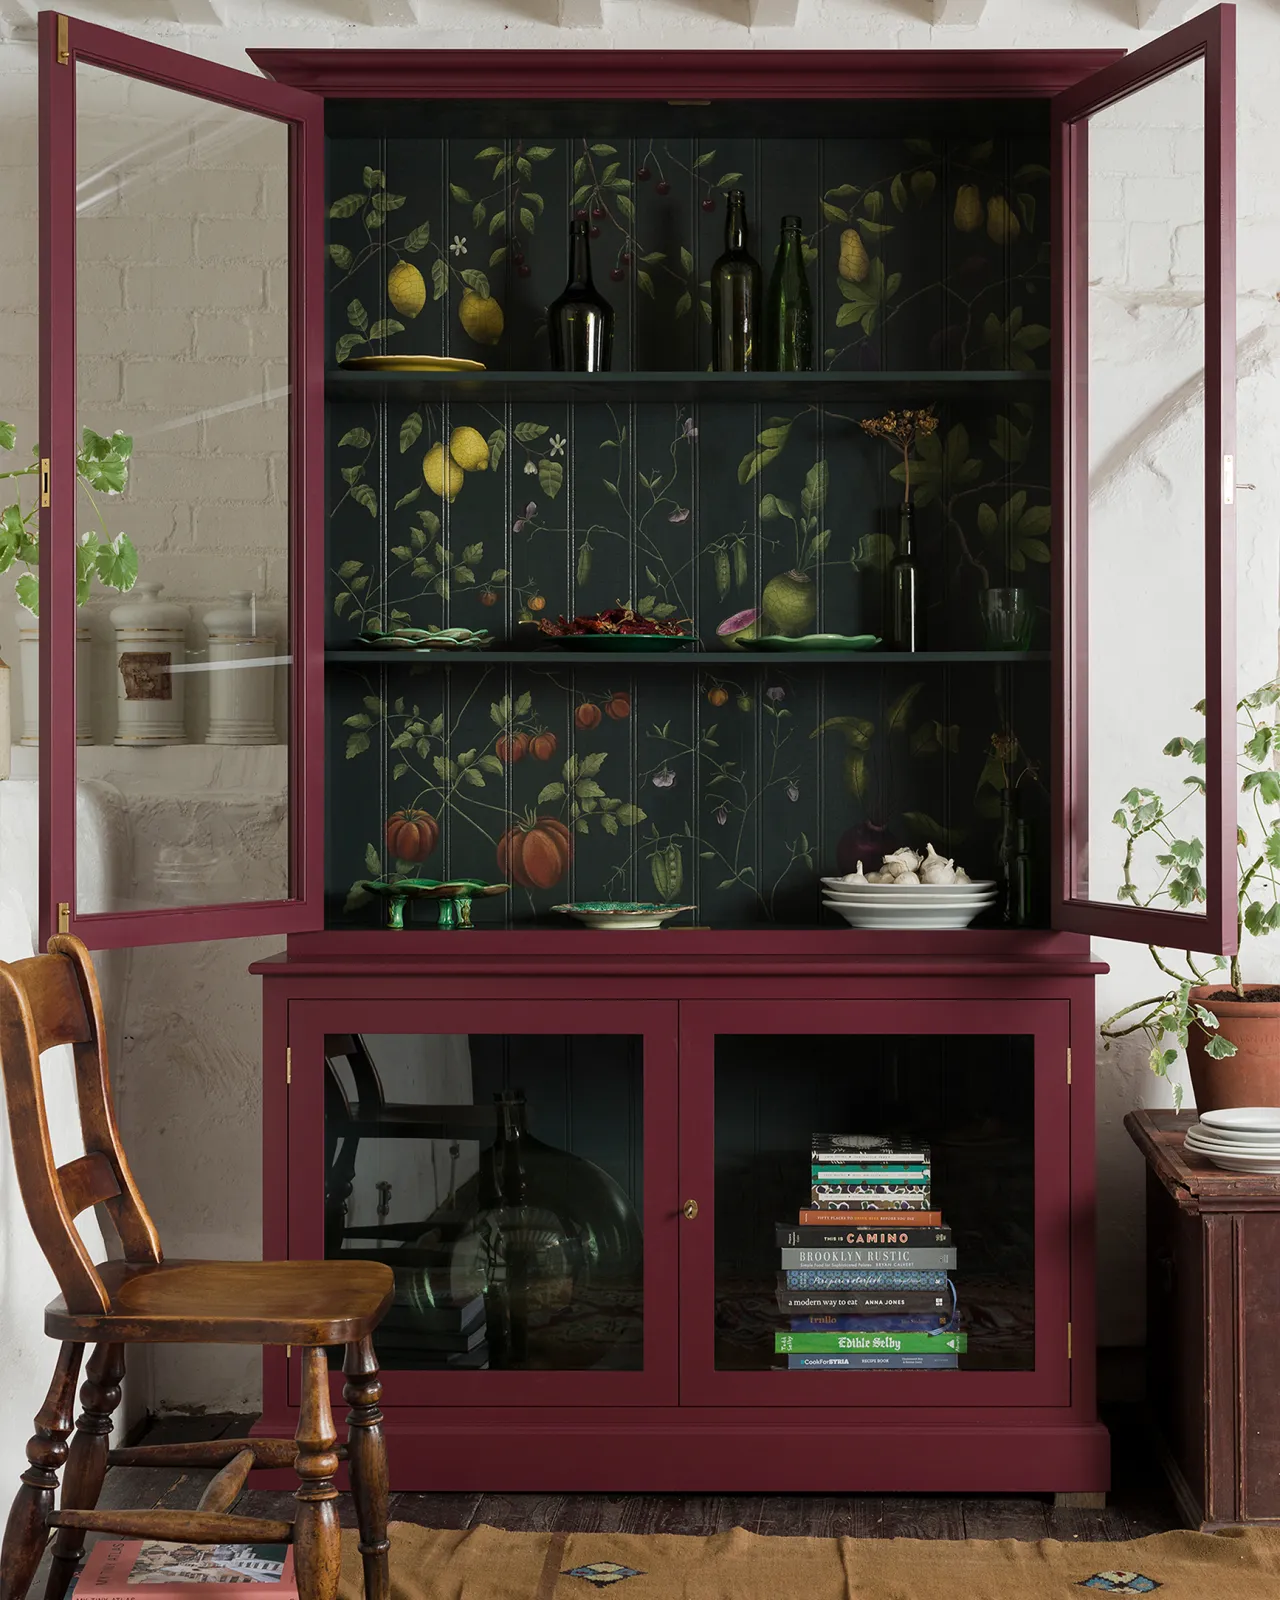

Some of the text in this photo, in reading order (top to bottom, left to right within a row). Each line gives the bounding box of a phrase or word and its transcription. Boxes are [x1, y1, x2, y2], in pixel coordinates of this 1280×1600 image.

[846, 1233, 909, 1244] CAMINO
[800, 1251, 910, 1262] BROOKLYN RUSTIC
[793, 1298, 822, 1306] modern
[822, 1300, 837, 1308] way
[838, 1336, 901, 1351] Edible Selby
